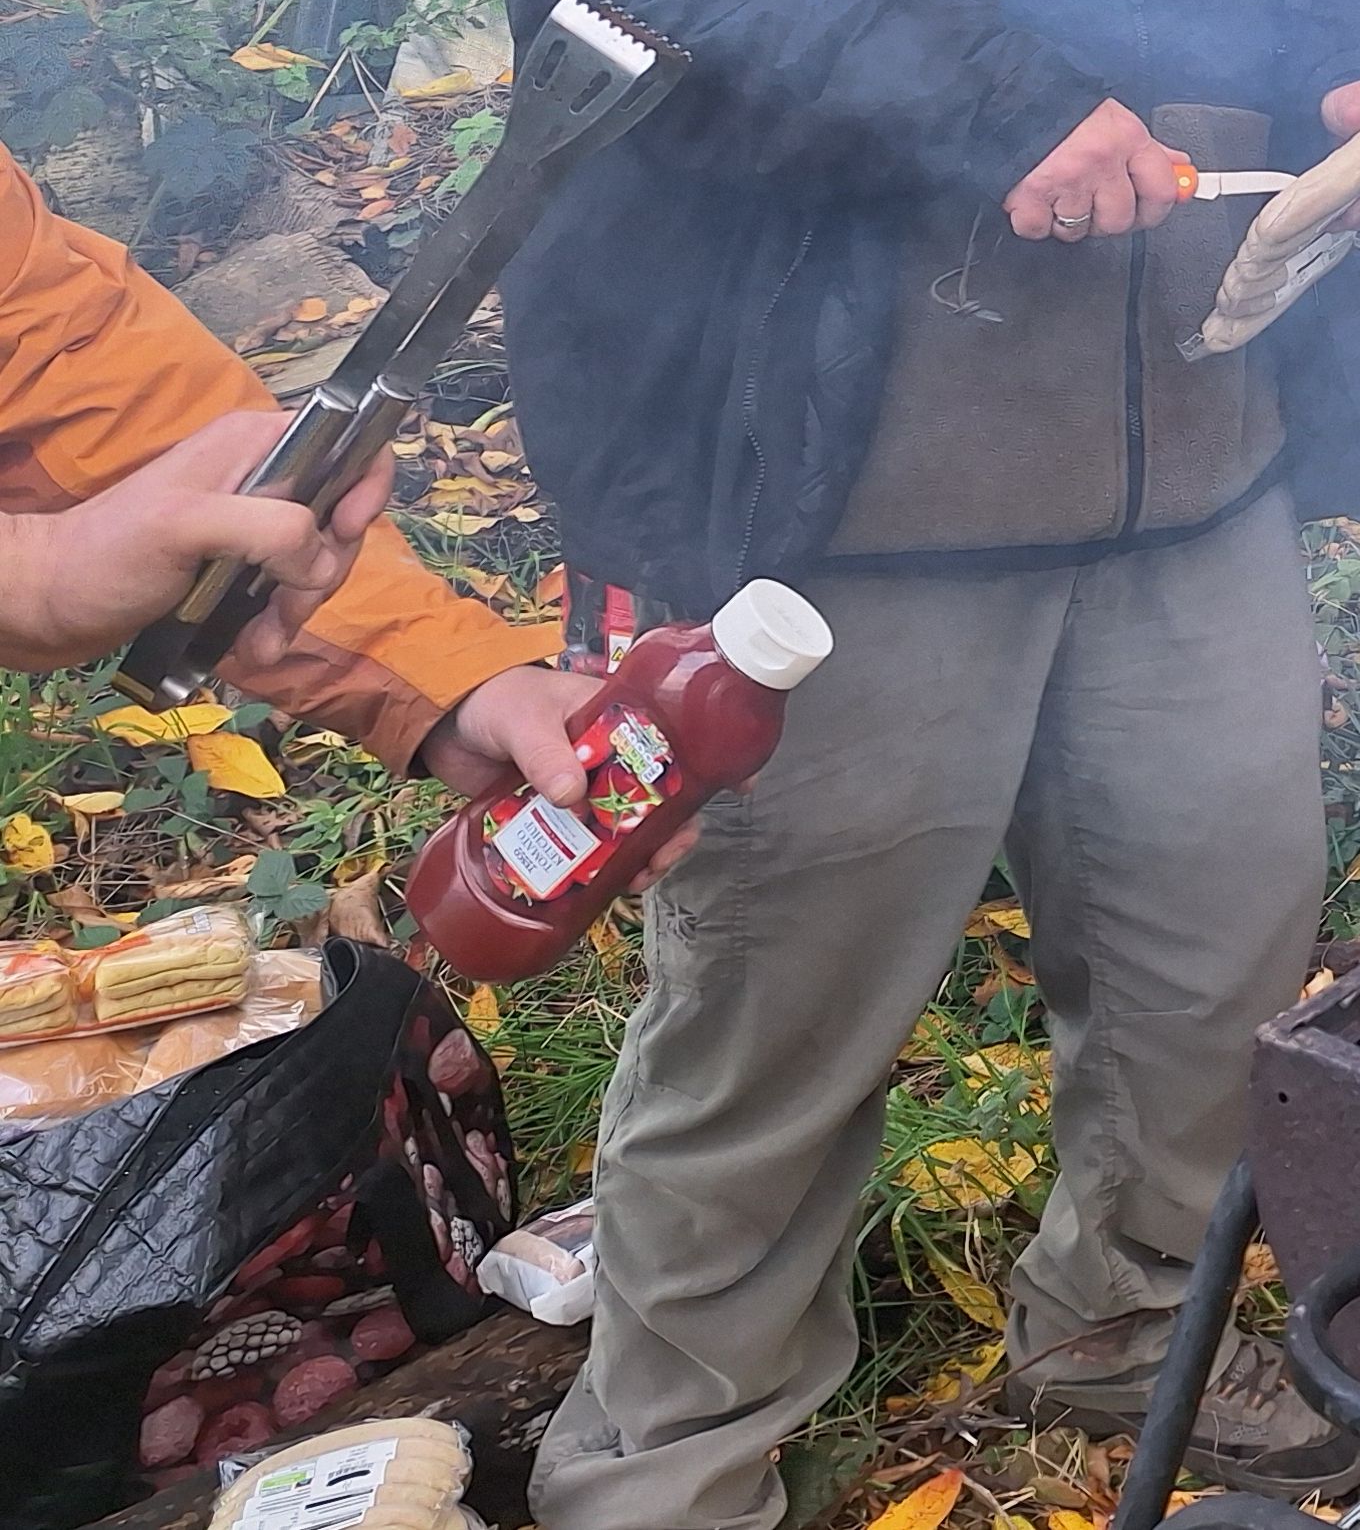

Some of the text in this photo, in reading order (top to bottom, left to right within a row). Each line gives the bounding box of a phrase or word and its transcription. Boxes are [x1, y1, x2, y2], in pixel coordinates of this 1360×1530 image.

[513, 847, 536, 874] TESCO
[516, 829, 552, 874] TOMATO
[524, 821, 564, 867] KETCHUP
